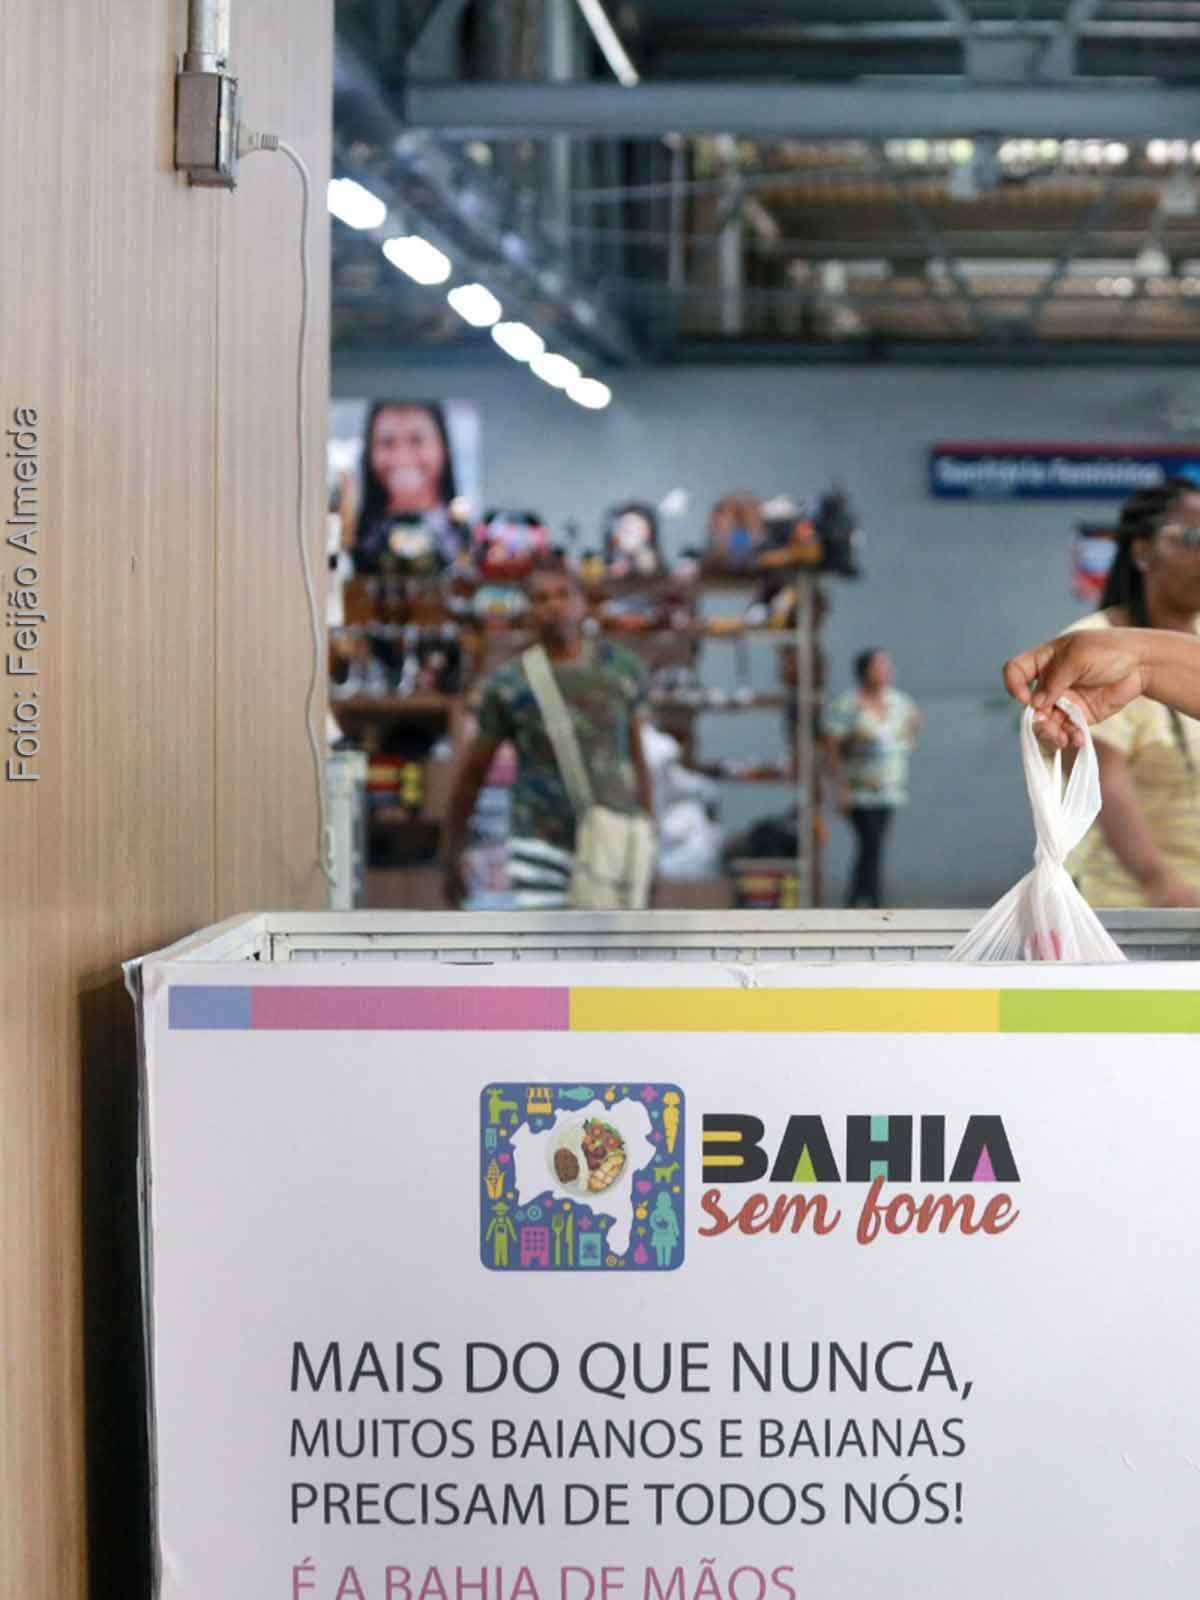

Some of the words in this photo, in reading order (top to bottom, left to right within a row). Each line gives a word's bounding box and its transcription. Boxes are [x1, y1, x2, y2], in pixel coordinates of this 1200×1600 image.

[701, 1113, 1022, 1184] BAHIA
[697, 1188, 842, 1238] sem
[856, 1174, 1021, 1245] fome
[289, 1341, 443, 1394] MAIS
[464, 1341, 560, 1394] DO
[578, 1341, 711, 1400] QUE
[732, 1340, 974, 1400] NUNCA,
[289, 1418, 475, 1459] MUITOS
[490, 1418, 704, 1459] BAIANOS
[719, 1418, 744, 1458] E
[758, 1417, 966, 1458] BAIANAS
[290, 1482, 546, 1526] PRECISAM
[563, 1482, 631, 1526] DE
[643, 1482, 826, 1526] TODOS
[843, 1473, 964, 1526] NÓS!
[290, 1556, 316, 1600] É
[334, 1565, 367, 1600] A
[384, 1565, 541, 1600] BAHIA
[560, 1566, 625, 1600] DE
[643, 1557, 798, 1600] MÃOS
